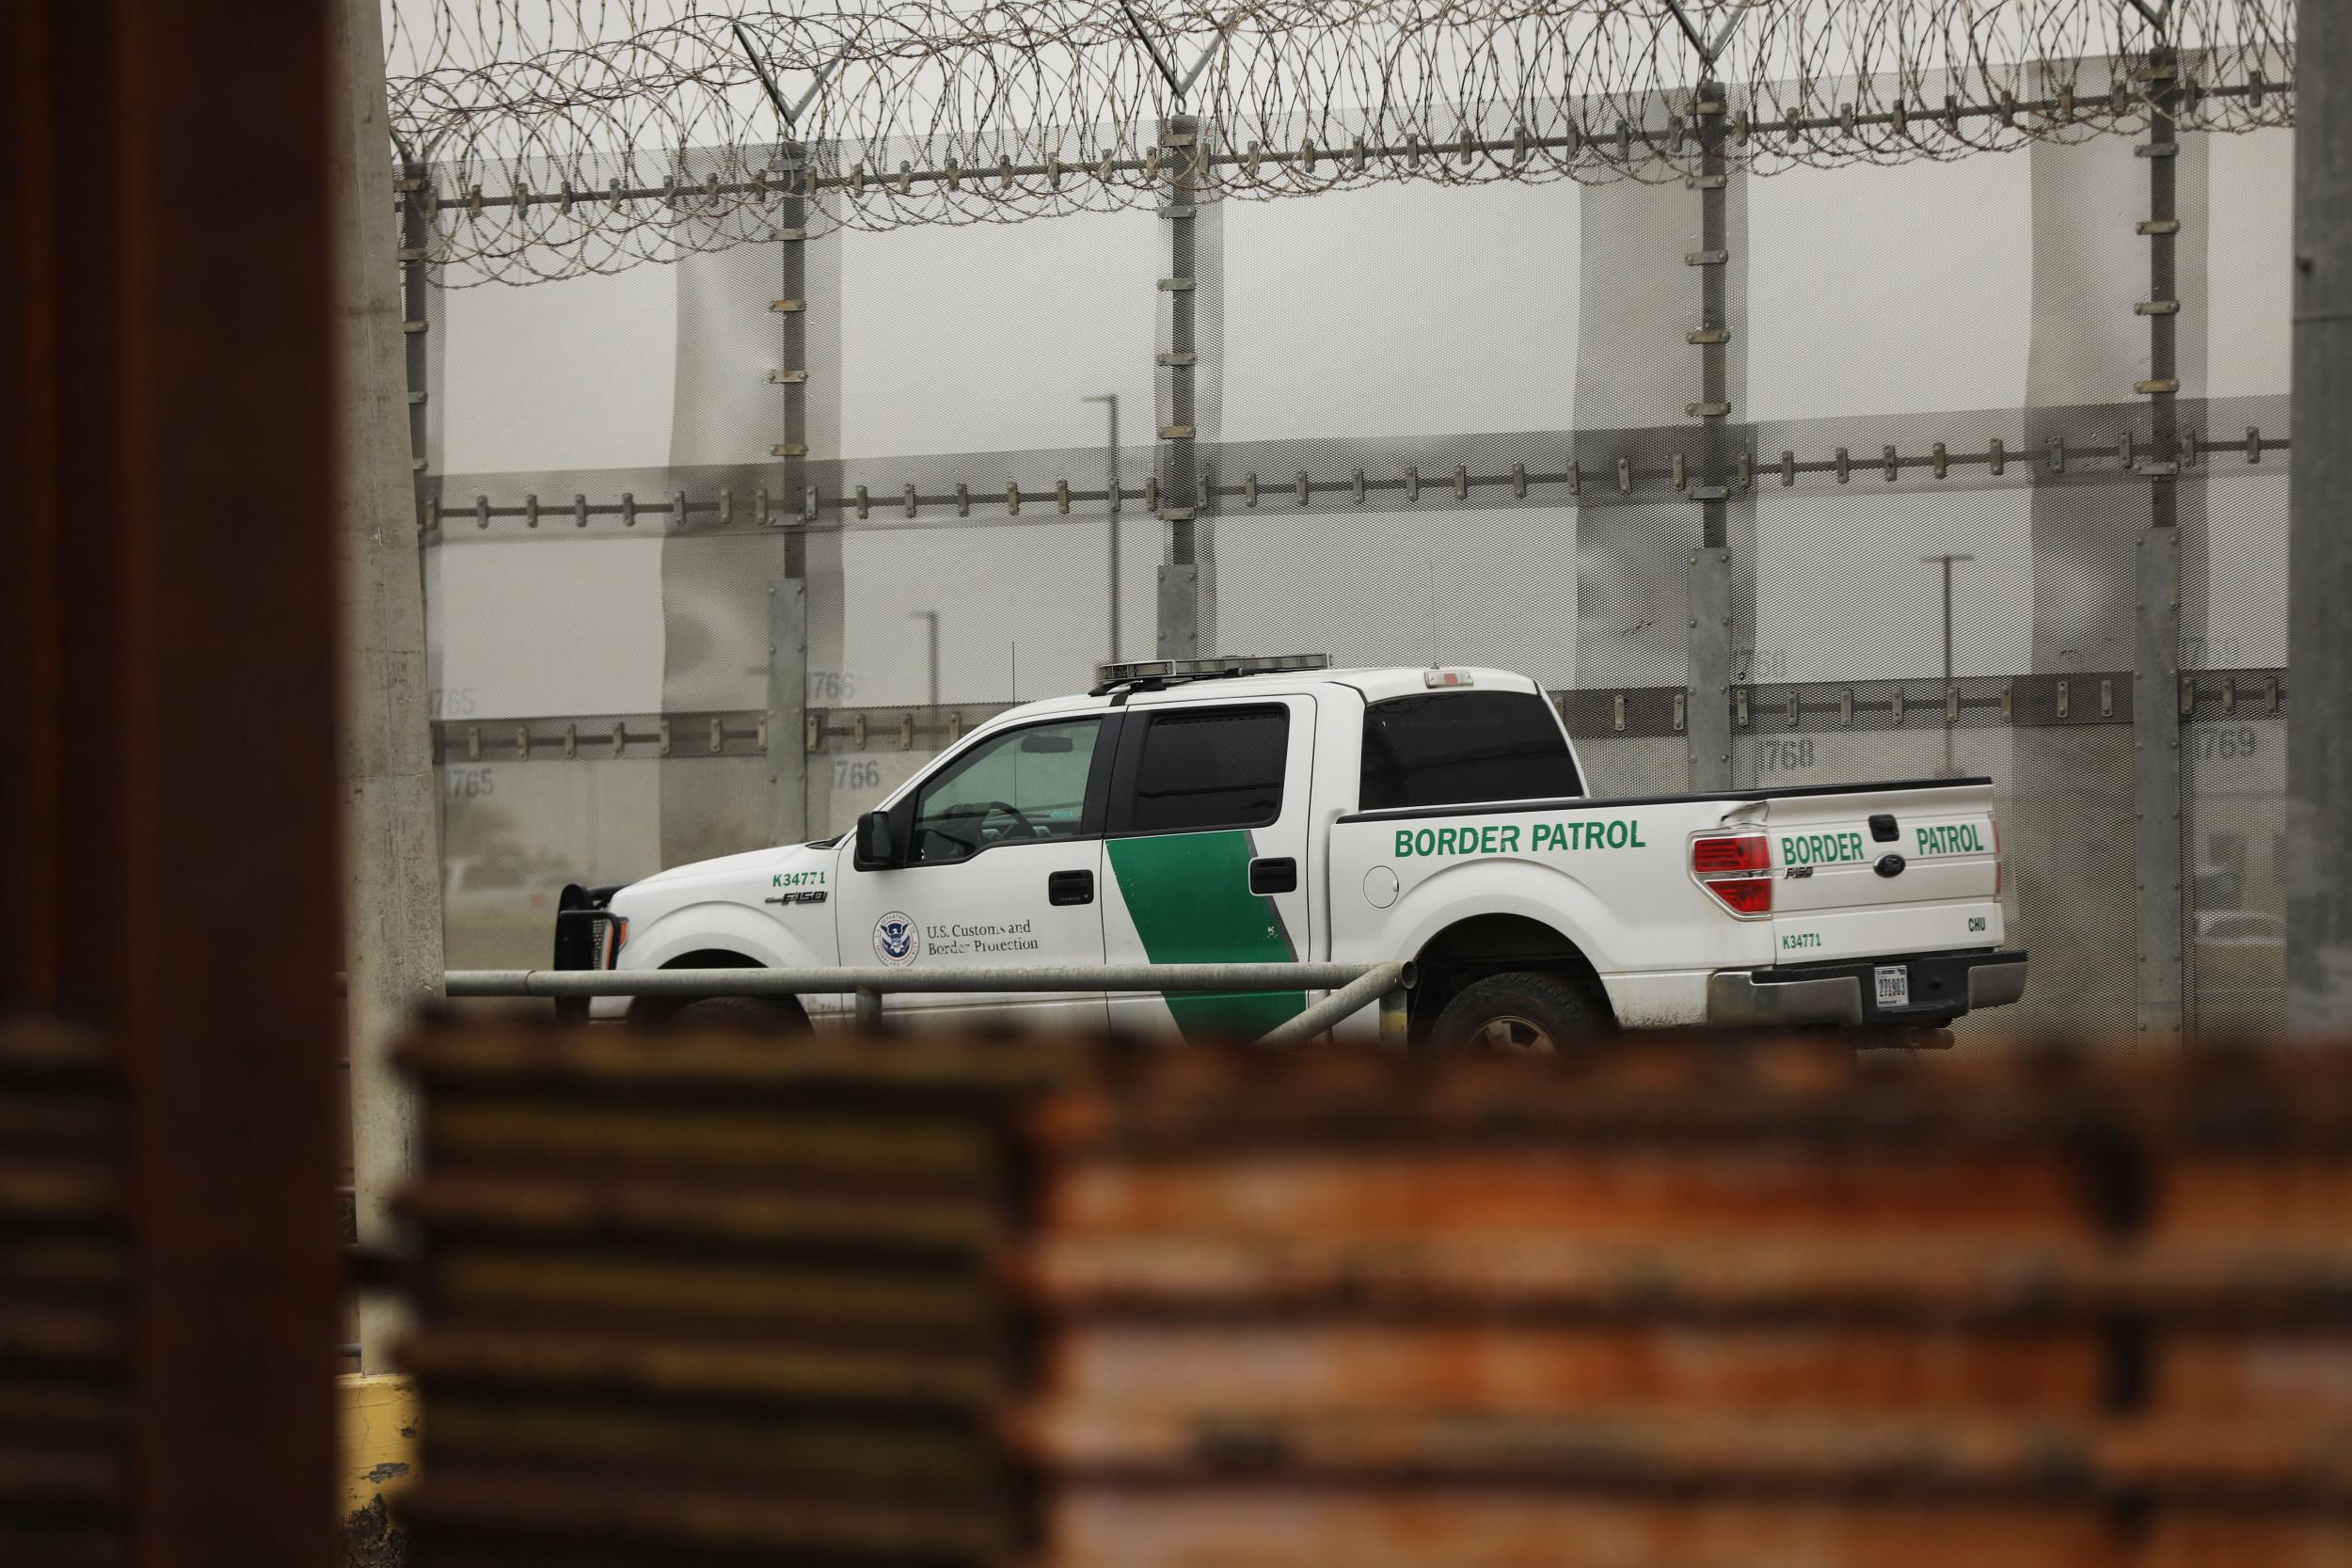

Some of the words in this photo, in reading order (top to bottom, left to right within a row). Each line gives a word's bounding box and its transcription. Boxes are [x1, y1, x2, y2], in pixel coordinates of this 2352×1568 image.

[1395, 825, 1519, 858] BORDER
[1532, 820, 1645, 852] PATROL
[1781, 832, 1865, 865] BORDER
[1915, 824, 1984, 856] PATROL
[772, 871, 826, 887] K34771
[926, 925, 950, 939] U.S.
[952, 924, 1006, 938] Customs
[1009, 919, 1032, 934] and
[1967, 917, 1986, 932] CHU
[1782, 932, 1822, 950] K34771
